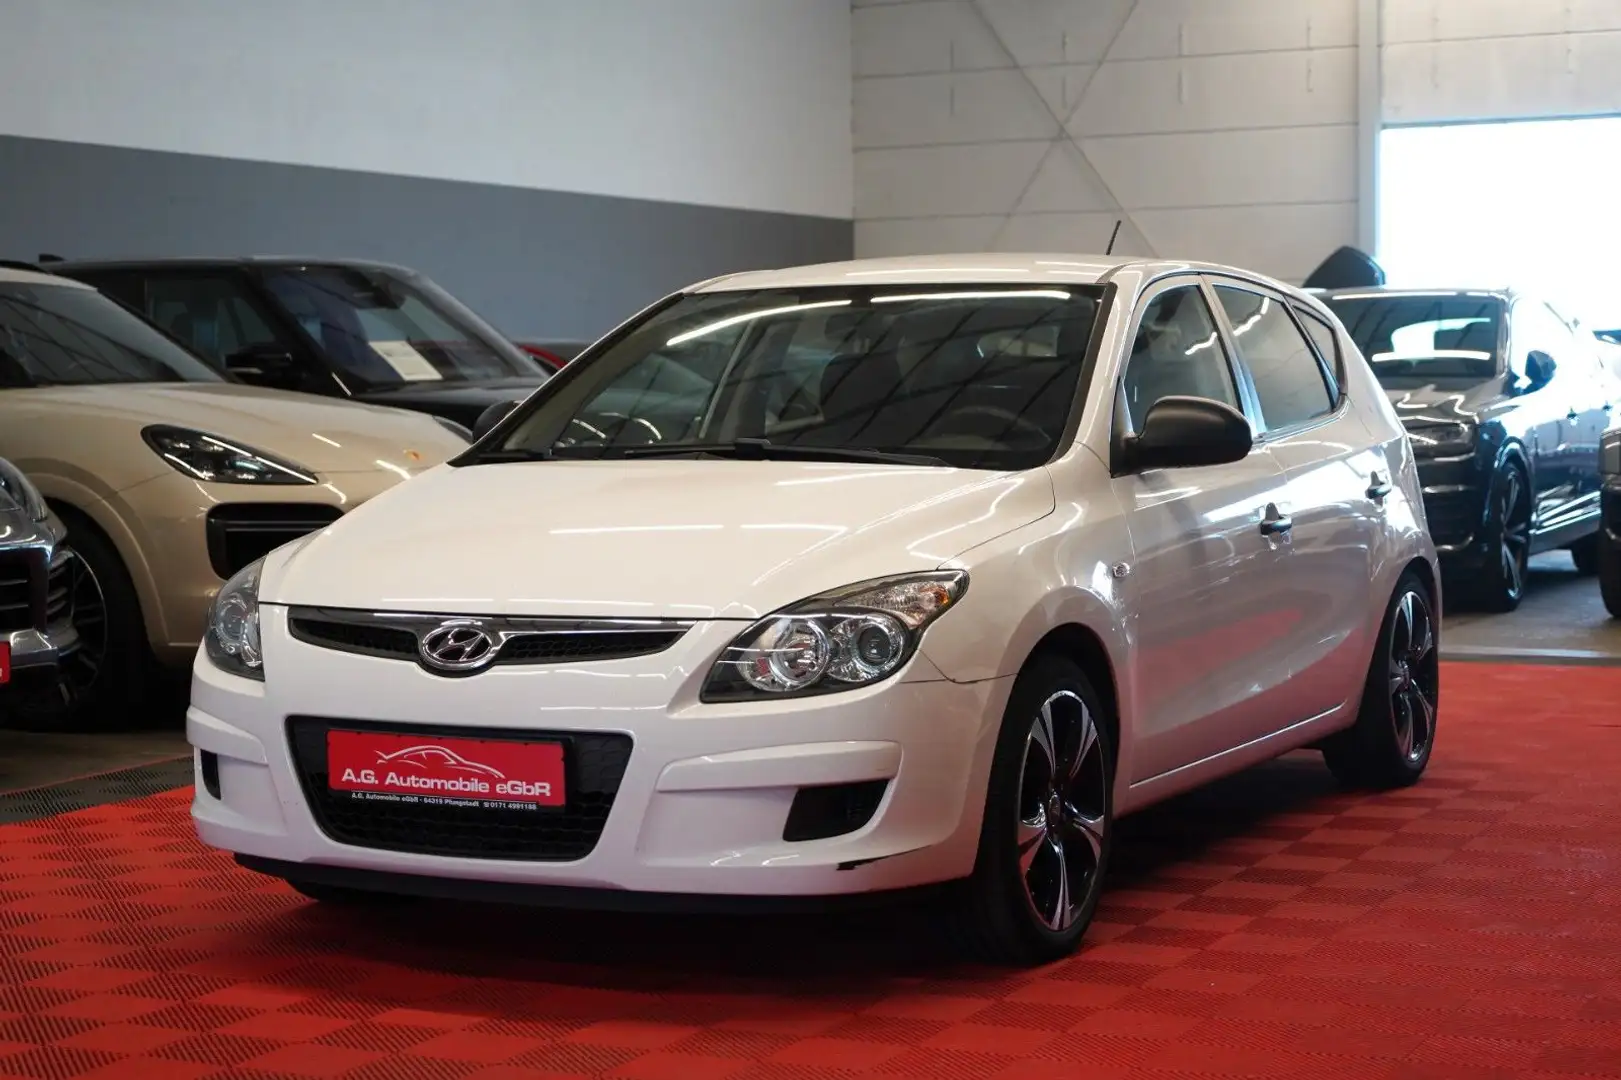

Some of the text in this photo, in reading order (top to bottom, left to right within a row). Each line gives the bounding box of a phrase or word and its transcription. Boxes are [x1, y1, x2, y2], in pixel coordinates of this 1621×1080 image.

[341, 768, 551, 797] A.G. Automobile eGbR
[366, 793, 400, 801] Automobile
